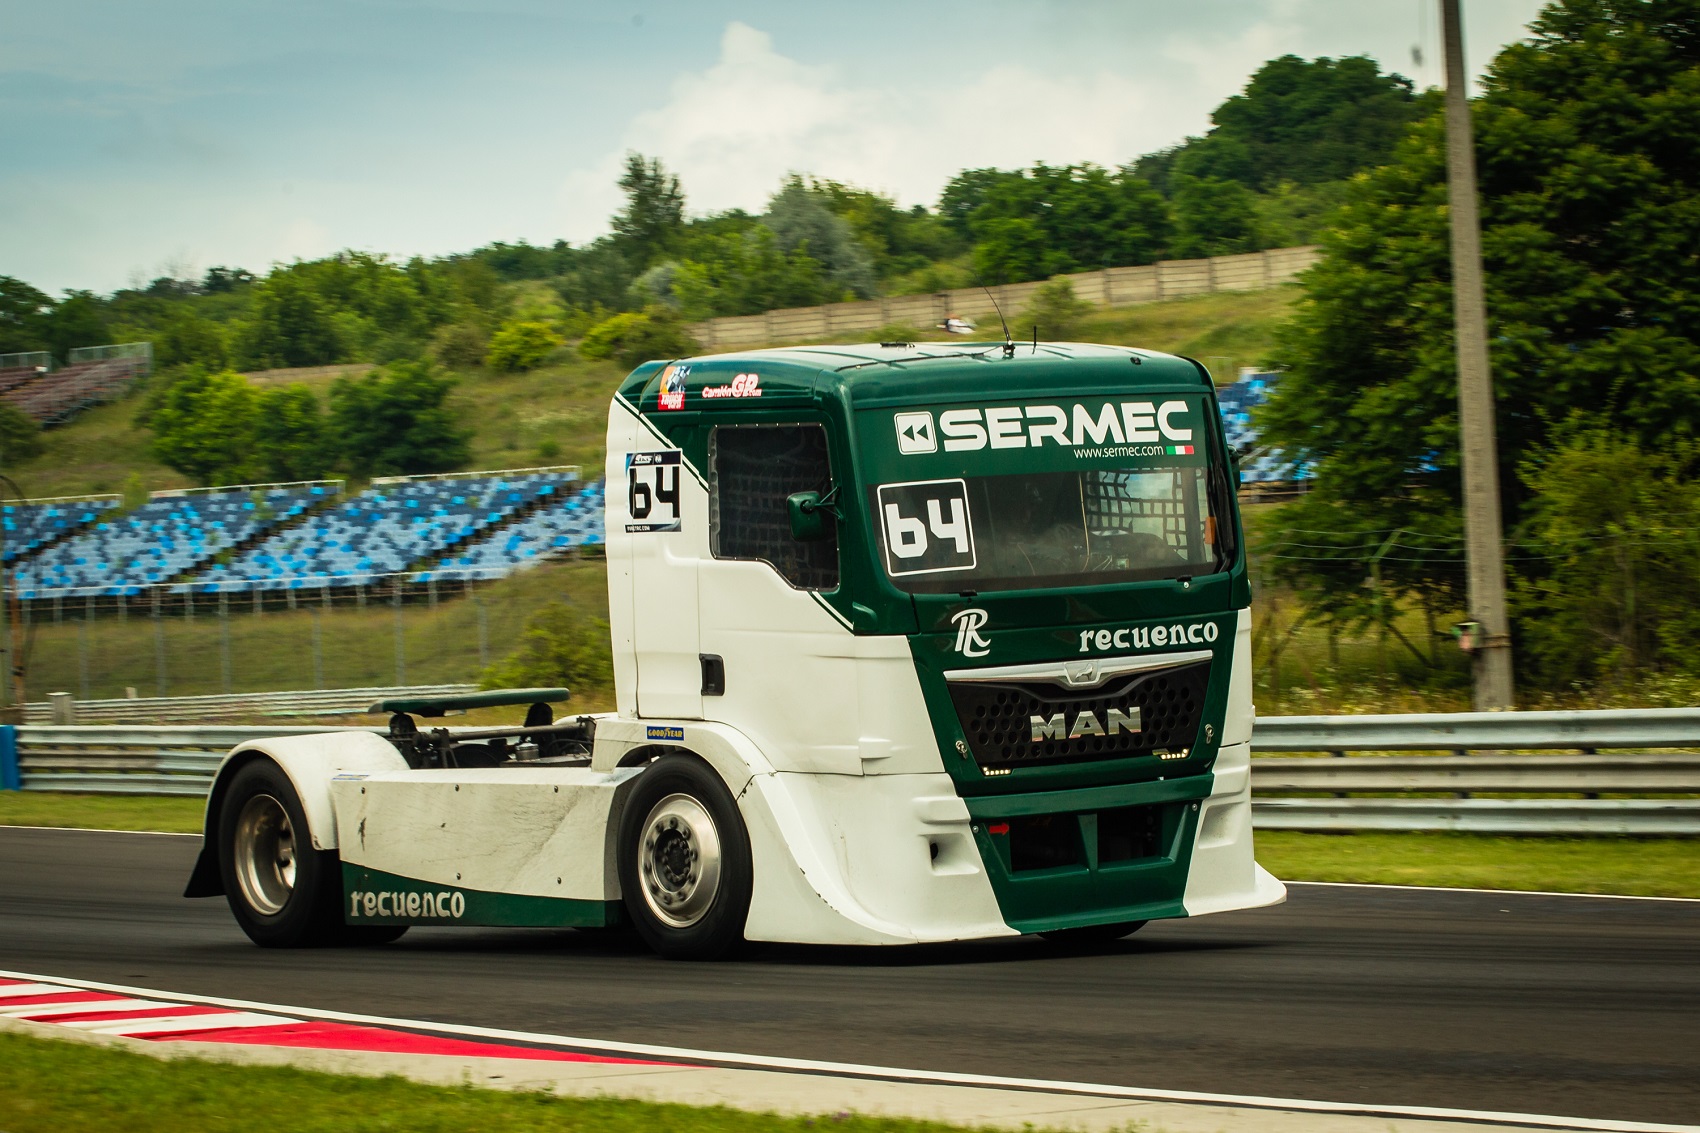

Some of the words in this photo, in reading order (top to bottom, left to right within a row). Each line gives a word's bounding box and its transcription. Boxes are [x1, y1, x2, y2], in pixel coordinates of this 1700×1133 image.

[939, 400, 1193, 452] SERMEC
[1073, 445, 1164, 459] www.sermec.com
[629, 466, 680, 519] 64
[885, 498, 969, 559] 64
[1079, 621, 1219, 652] recuenco
[1030, 706, 1142, 742] MAN
[350, 891, 465, 918] recuenco
